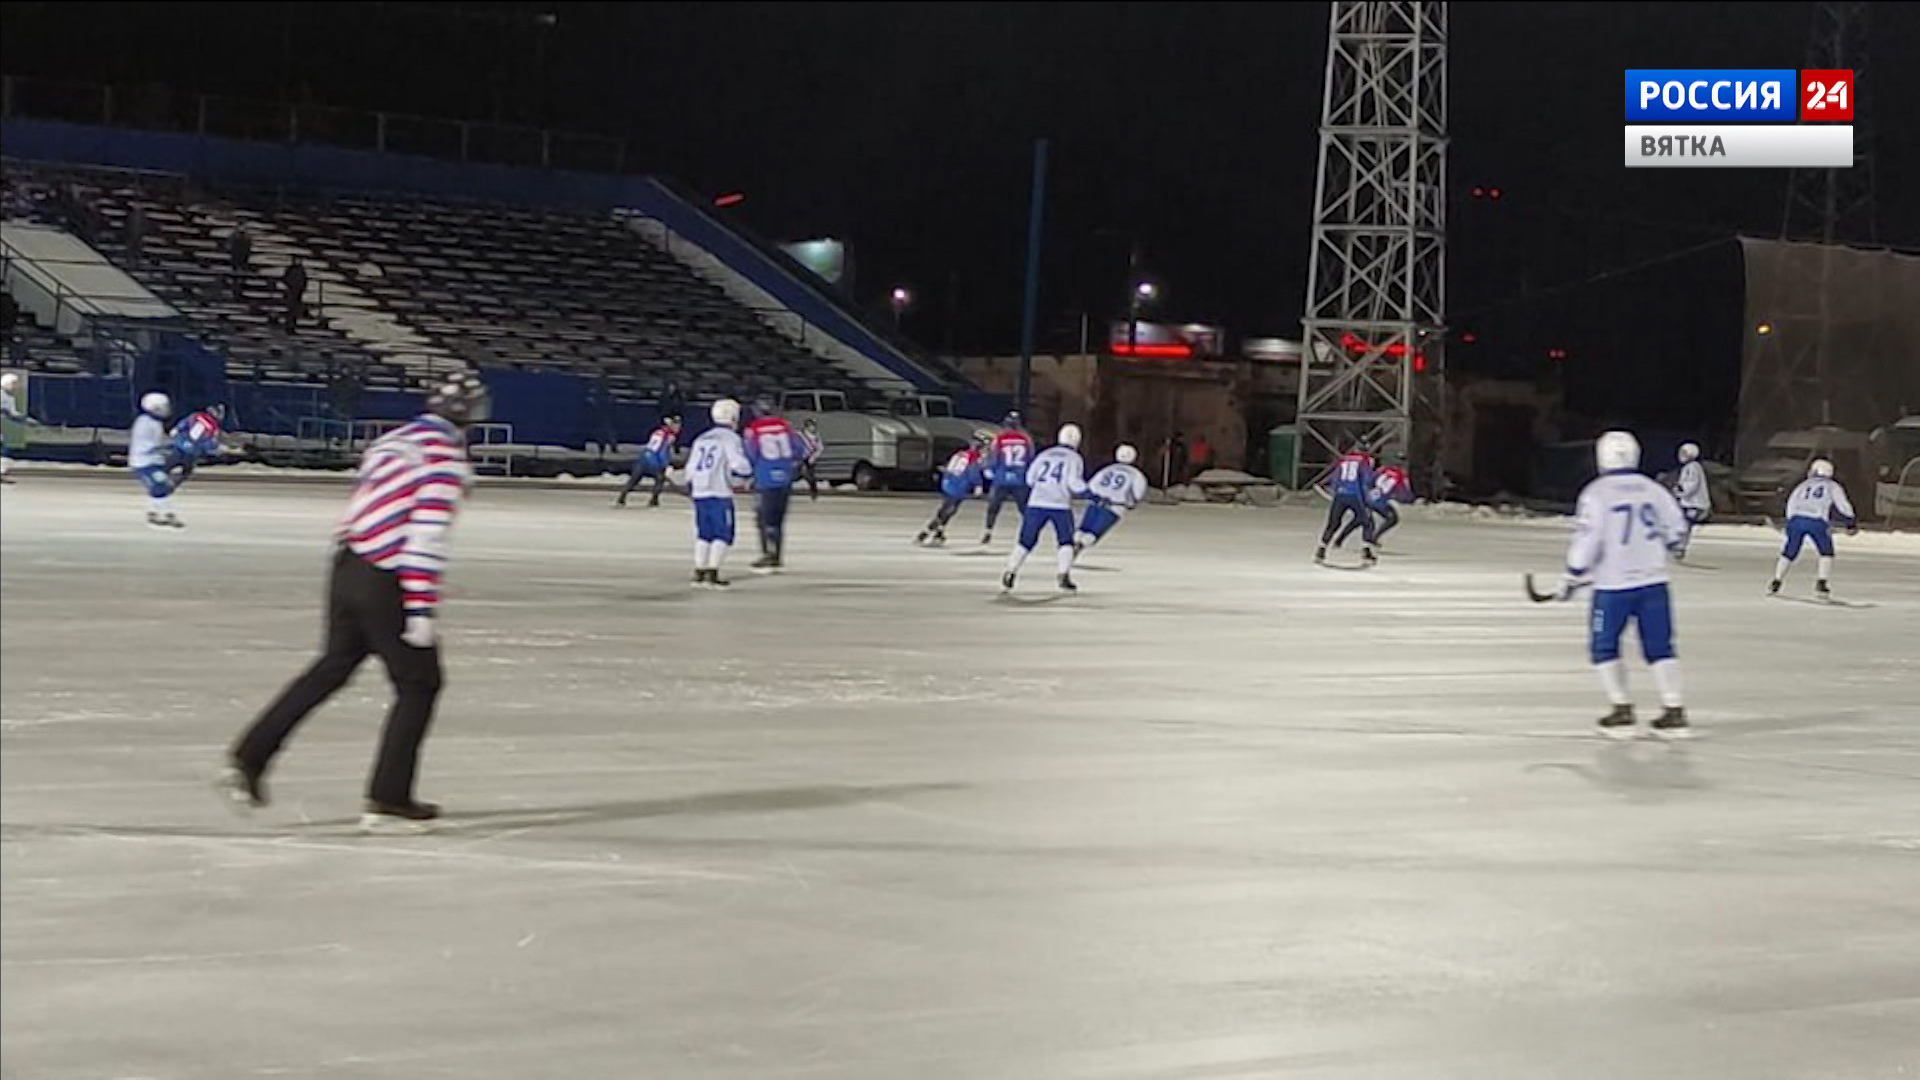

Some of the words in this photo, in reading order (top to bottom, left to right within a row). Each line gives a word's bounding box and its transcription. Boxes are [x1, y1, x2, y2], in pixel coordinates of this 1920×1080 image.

[1001, 445, 1026, 466] 12
[1037, 461, 1064, 483] 24
[1804, 485, 1825, 500] 14
[1612, 503, 1658, 545] 79
